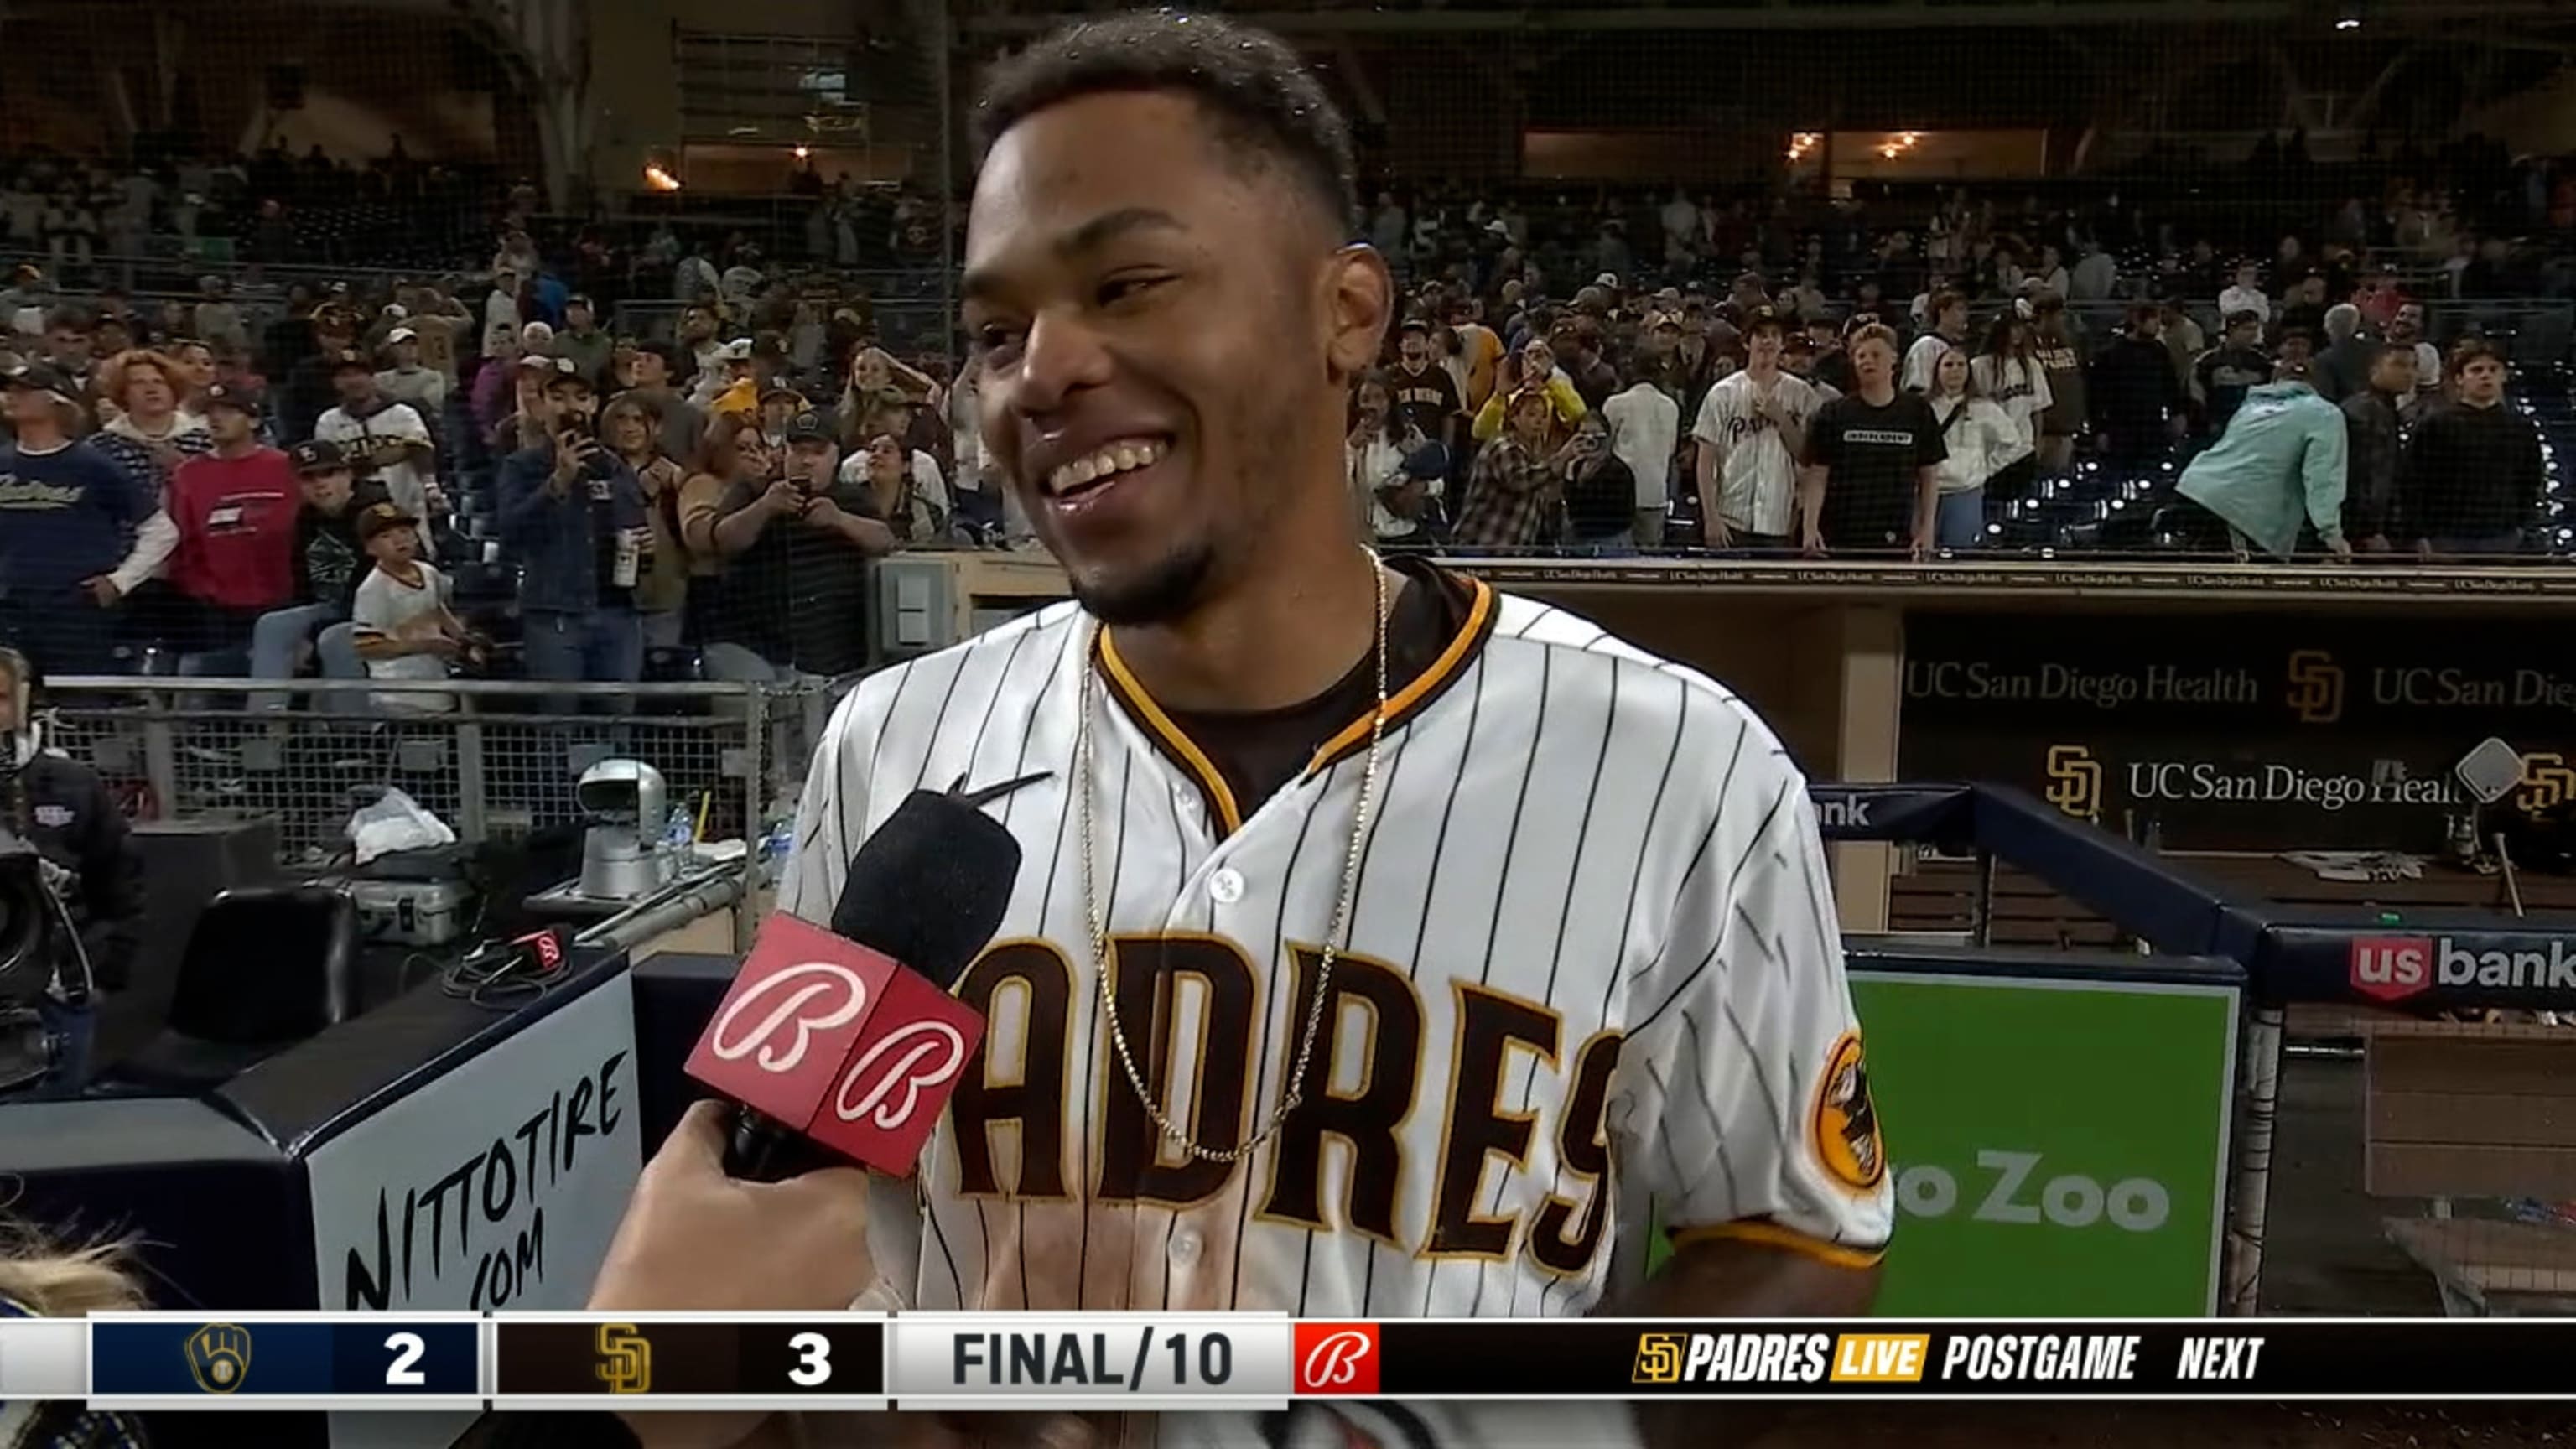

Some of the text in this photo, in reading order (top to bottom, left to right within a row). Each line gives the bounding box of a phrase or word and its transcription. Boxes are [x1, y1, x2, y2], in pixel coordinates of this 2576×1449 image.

[1906, 661, 2257, 709] UC San Diego Health
[2373, 667, 2576, 713] UC San Die
[2127, 762, 2185, 798] UC
[2190, 764, 2257, 801] San
[2264, 765, 2365, 810] Diego
[2359, 937, 2576, 988] us bank
[712, 962, 866, 1072] B
[836, 1020, 964, 1130] B
[948, 931, 1625, 1278] ADRES
[1893, 1150, 2170, 1232] o Zoo
